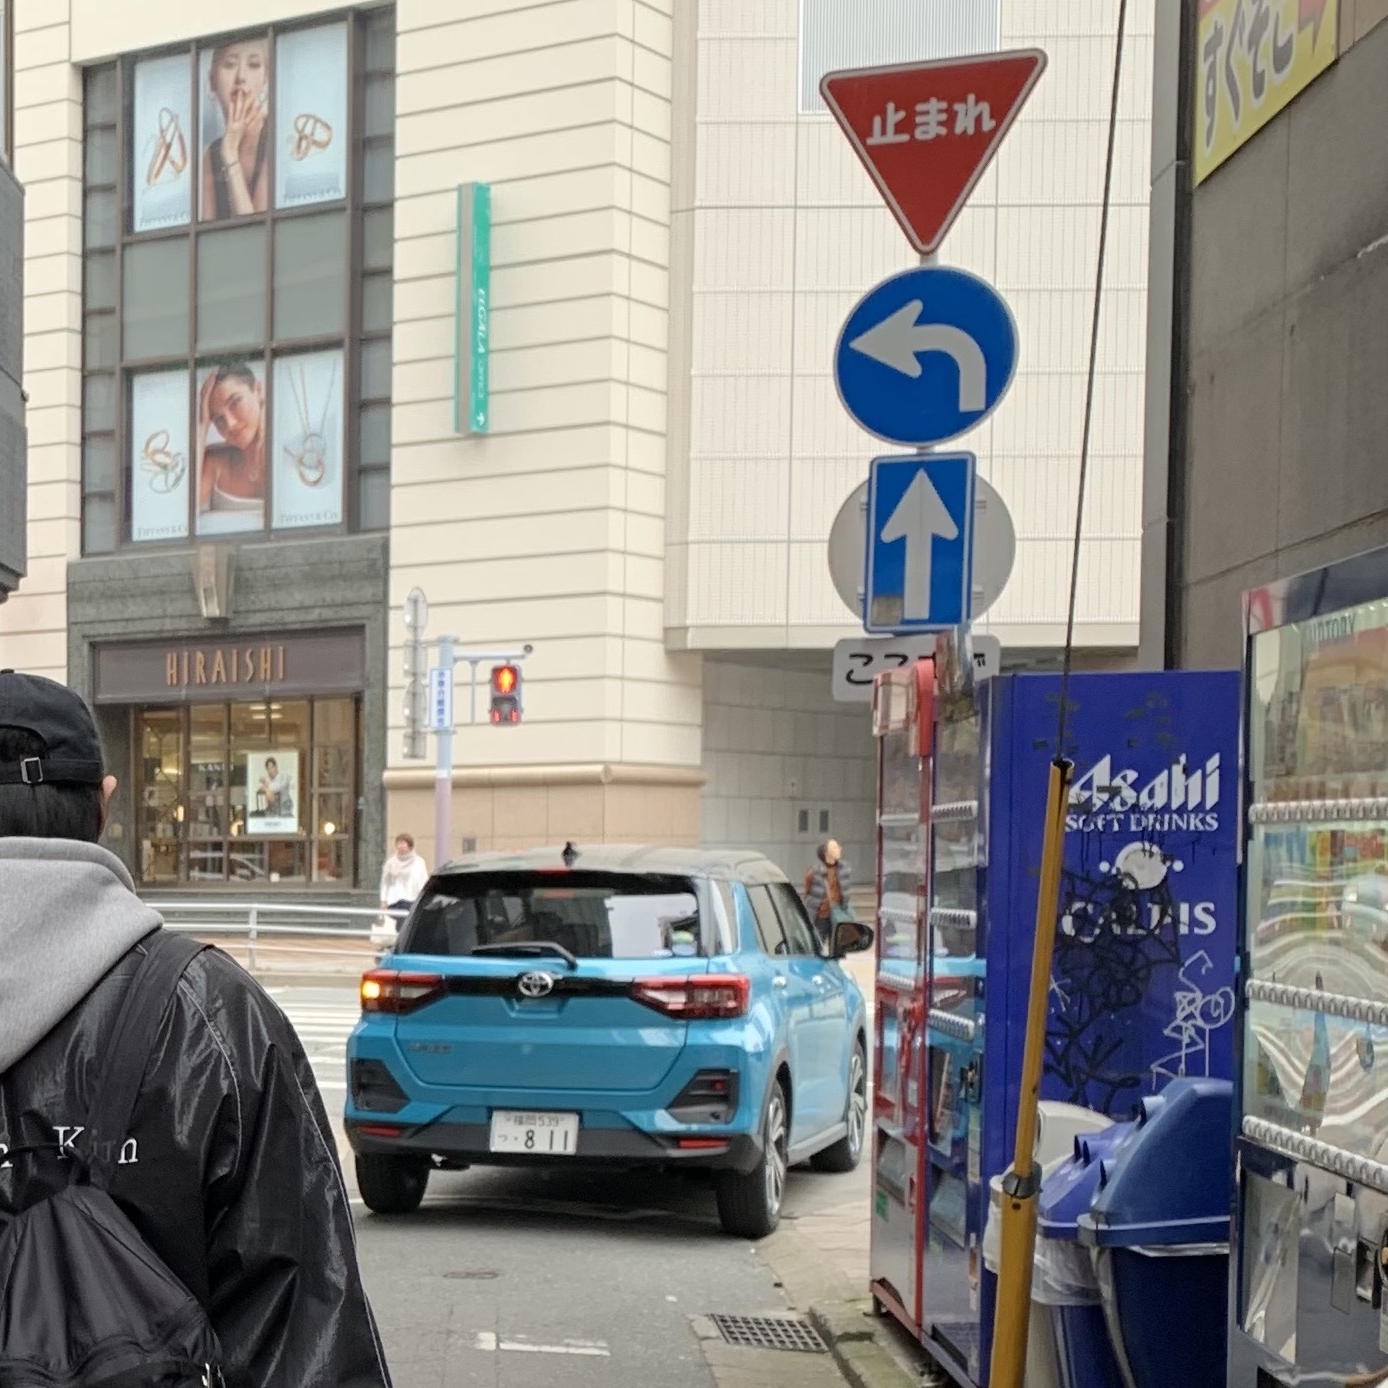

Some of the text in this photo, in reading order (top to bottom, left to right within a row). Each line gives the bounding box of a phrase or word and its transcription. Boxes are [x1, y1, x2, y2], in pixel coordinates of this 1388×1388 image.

[866, 93, 996, 145] 止まれ
[167, 646, 284, 686] HIRAISHI
[1068, 752, 1221, 812] Asahi
[538, 1115, 559, 1127] 539
